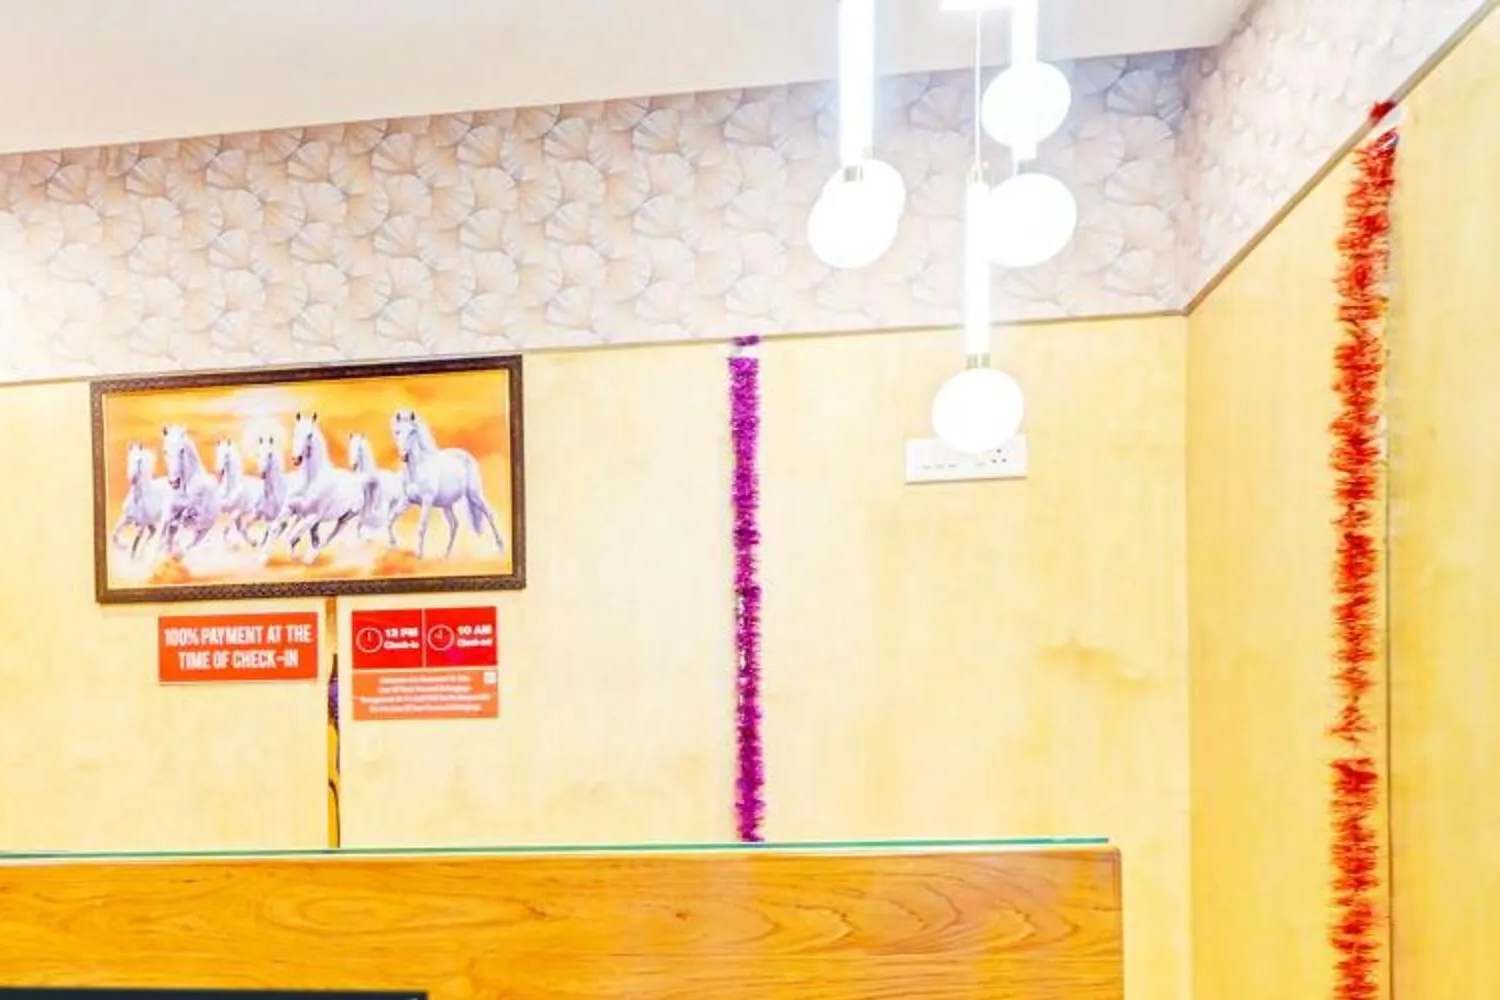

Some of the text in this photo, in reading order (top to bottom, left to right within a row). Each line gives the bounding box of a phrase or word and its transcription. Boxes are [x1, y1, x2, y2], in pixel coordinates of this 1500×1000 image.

[164, 623, 312, 646] 100% PAYMENT AT THE
[178, 649, 299, 670] TIME OF CHECK-IN
